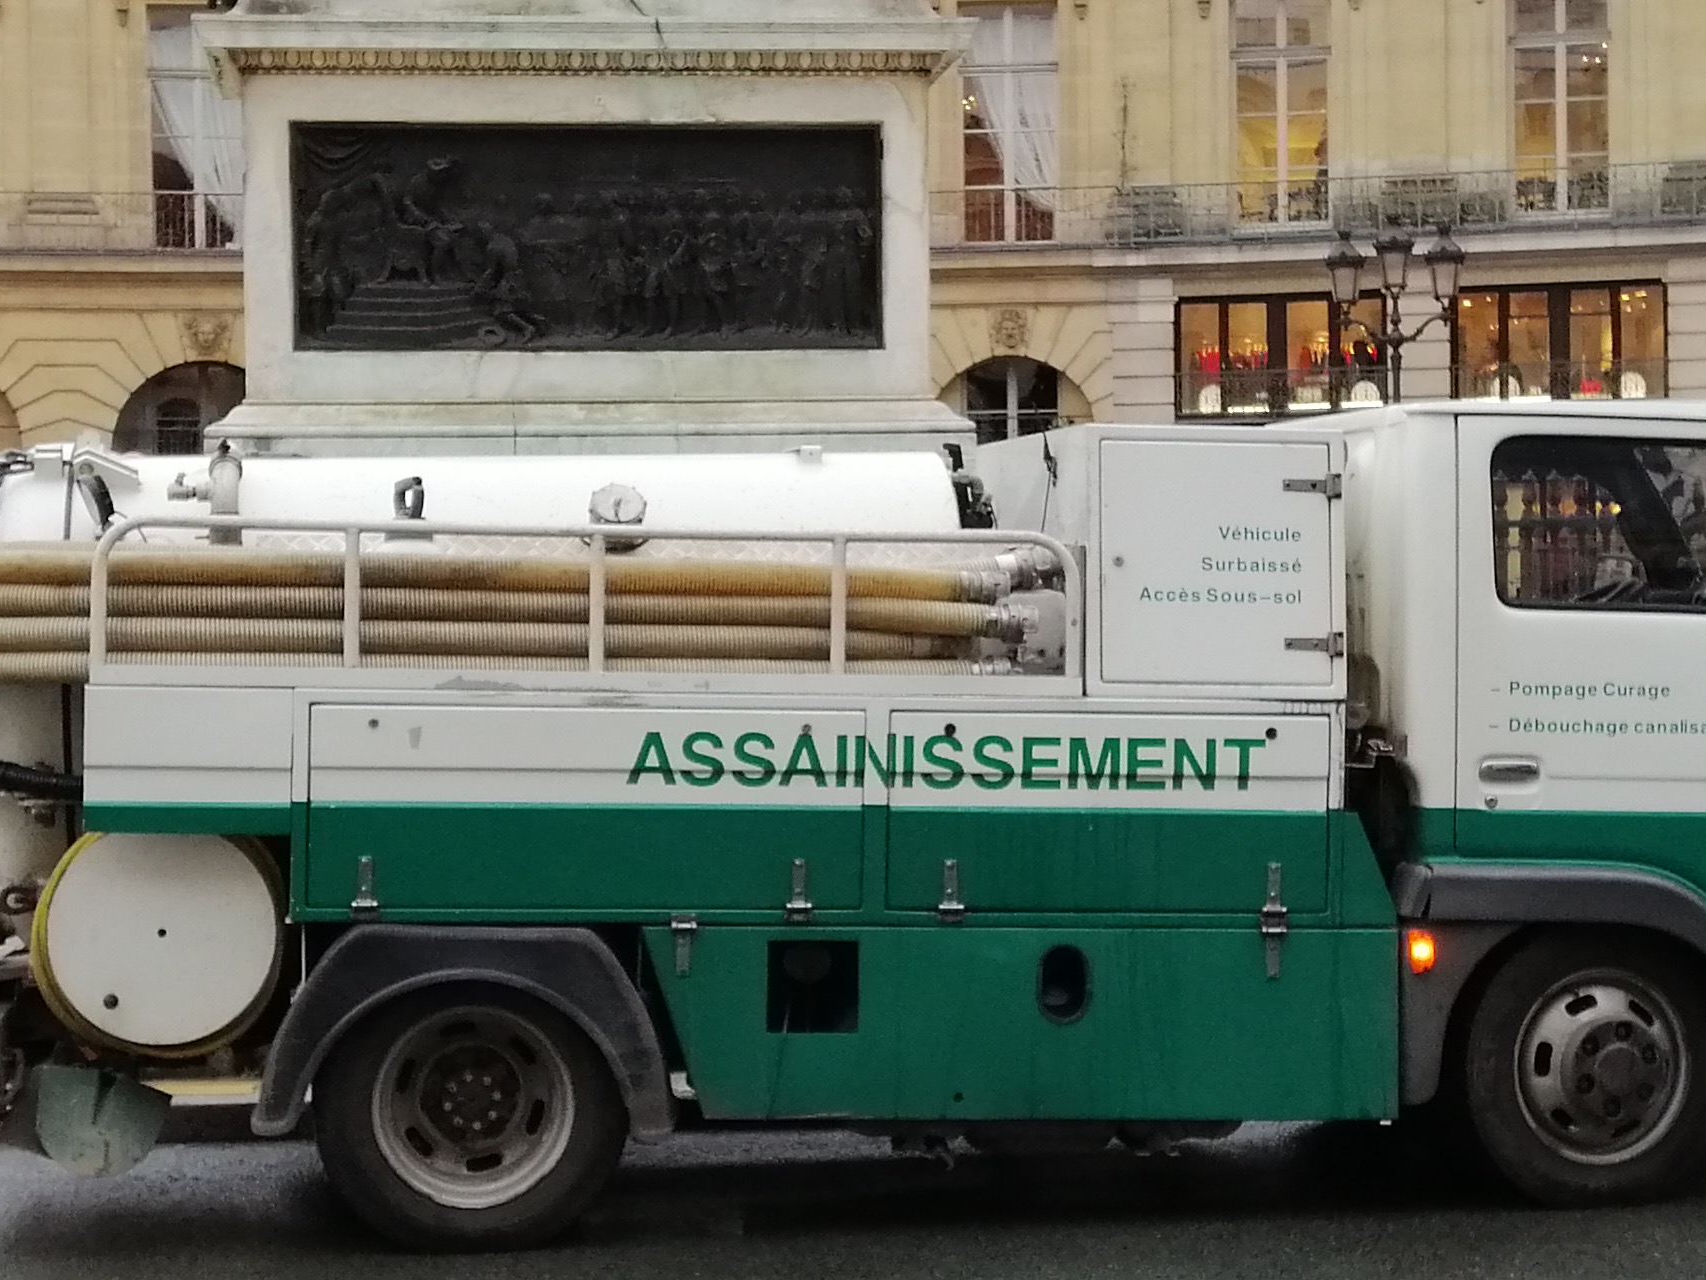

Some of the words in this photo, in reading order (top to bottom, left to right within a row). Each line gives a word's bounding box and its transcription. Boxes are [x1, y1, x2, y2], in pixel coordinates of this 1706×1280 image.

[1219, 526, 1301, 541] Véhicule
[1202, 557, 1302, 573] Surbaissé
[1140, 587, 1201, 602] Accès
[1509, 681, 1597, 700] Pompage
[1603, 682, 1671, 700] Curage
[1509, 718, 1629, 737] Débouchage
[626, 731, 1267, 791] ASSAINISSEMENT
